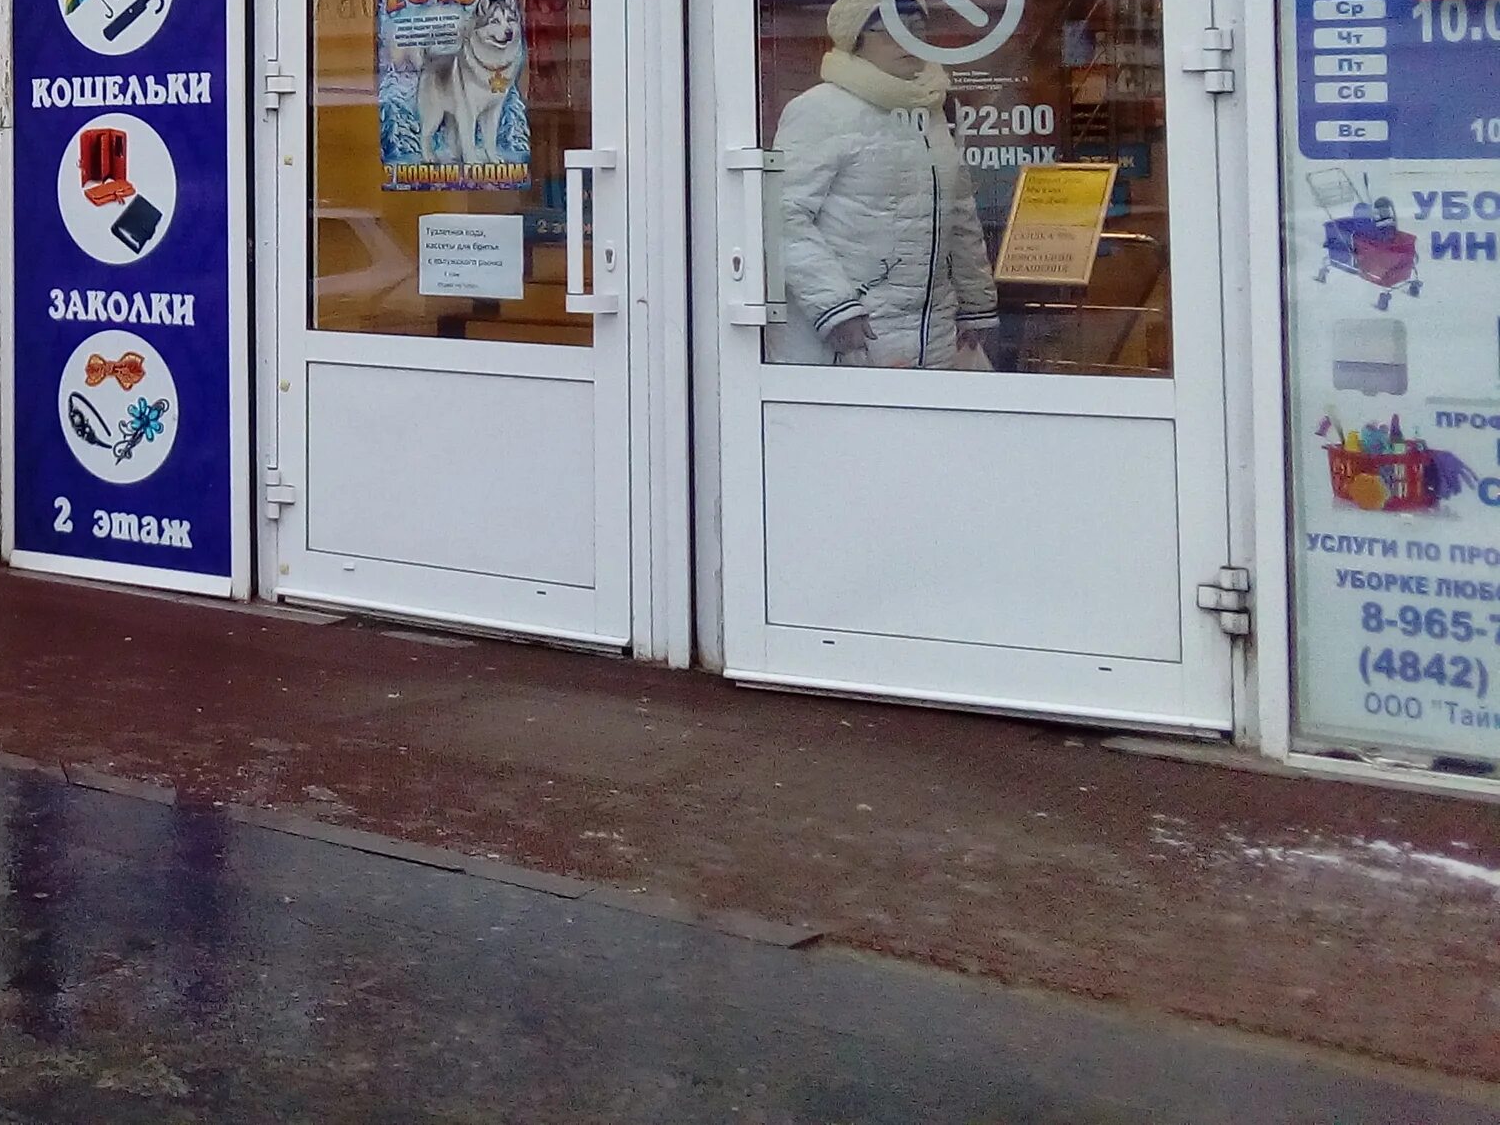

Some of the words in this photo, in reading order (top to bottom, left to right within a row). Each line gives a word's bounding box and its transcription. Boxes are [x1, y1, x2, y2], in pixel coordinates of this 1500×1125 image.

[1335, 1, 1363, 17] Ср
[1338, 32, 1363, 45] Чт
[1338, 58, 1364, 72] Пт
[31, 72, 212, 108] КОШЕЛЬКИ
[1338, 85, 1365, 100] Сб
[1338, 124, 1366, 138] Вс
[48, 288, 195, 327] ЗАКОЛКИ
[53, 496, 73, 533] 2
[92, 508, 193, 549] этаж
[1306, 532, 1398, 559] УСЛУГИ
[1406, 540, 1440, 562] ПО
[1336, 569, 1429, 596] УБОРКЕ
[1359, 645, 1489, 699] (4842)
[1364, 691, 1423, 720] ООО
